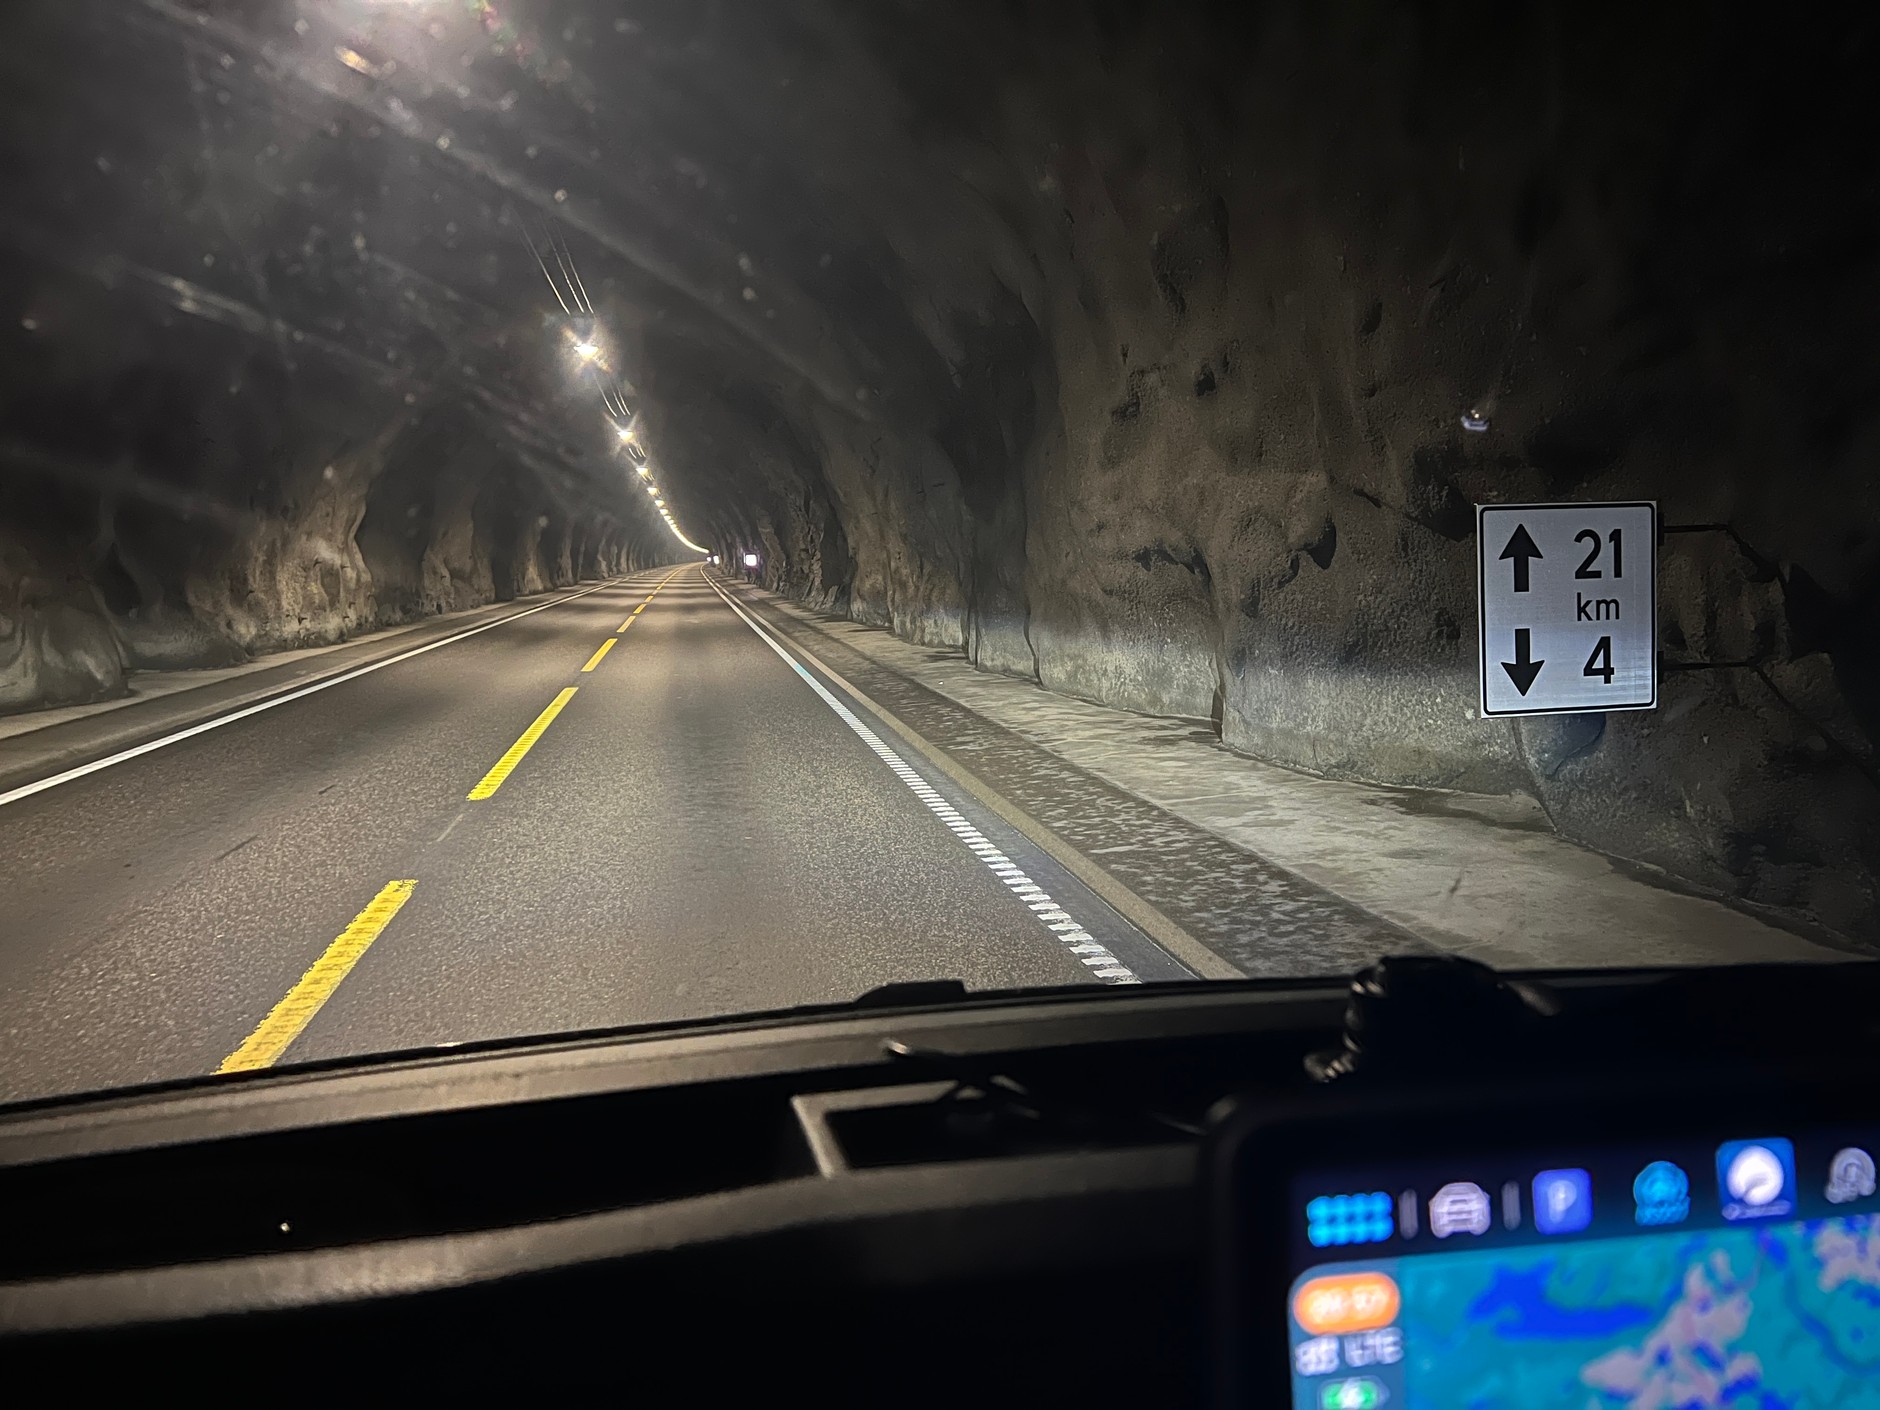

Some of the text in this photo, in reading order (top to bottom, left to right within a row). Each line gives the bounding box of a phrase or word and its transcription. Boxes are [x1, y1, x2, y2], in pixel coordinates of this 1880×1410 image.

[1573, 528, 1622, 580] 21
[1576, 591, 1620, 622] km
[1583, 635, 1615, 685] 4
